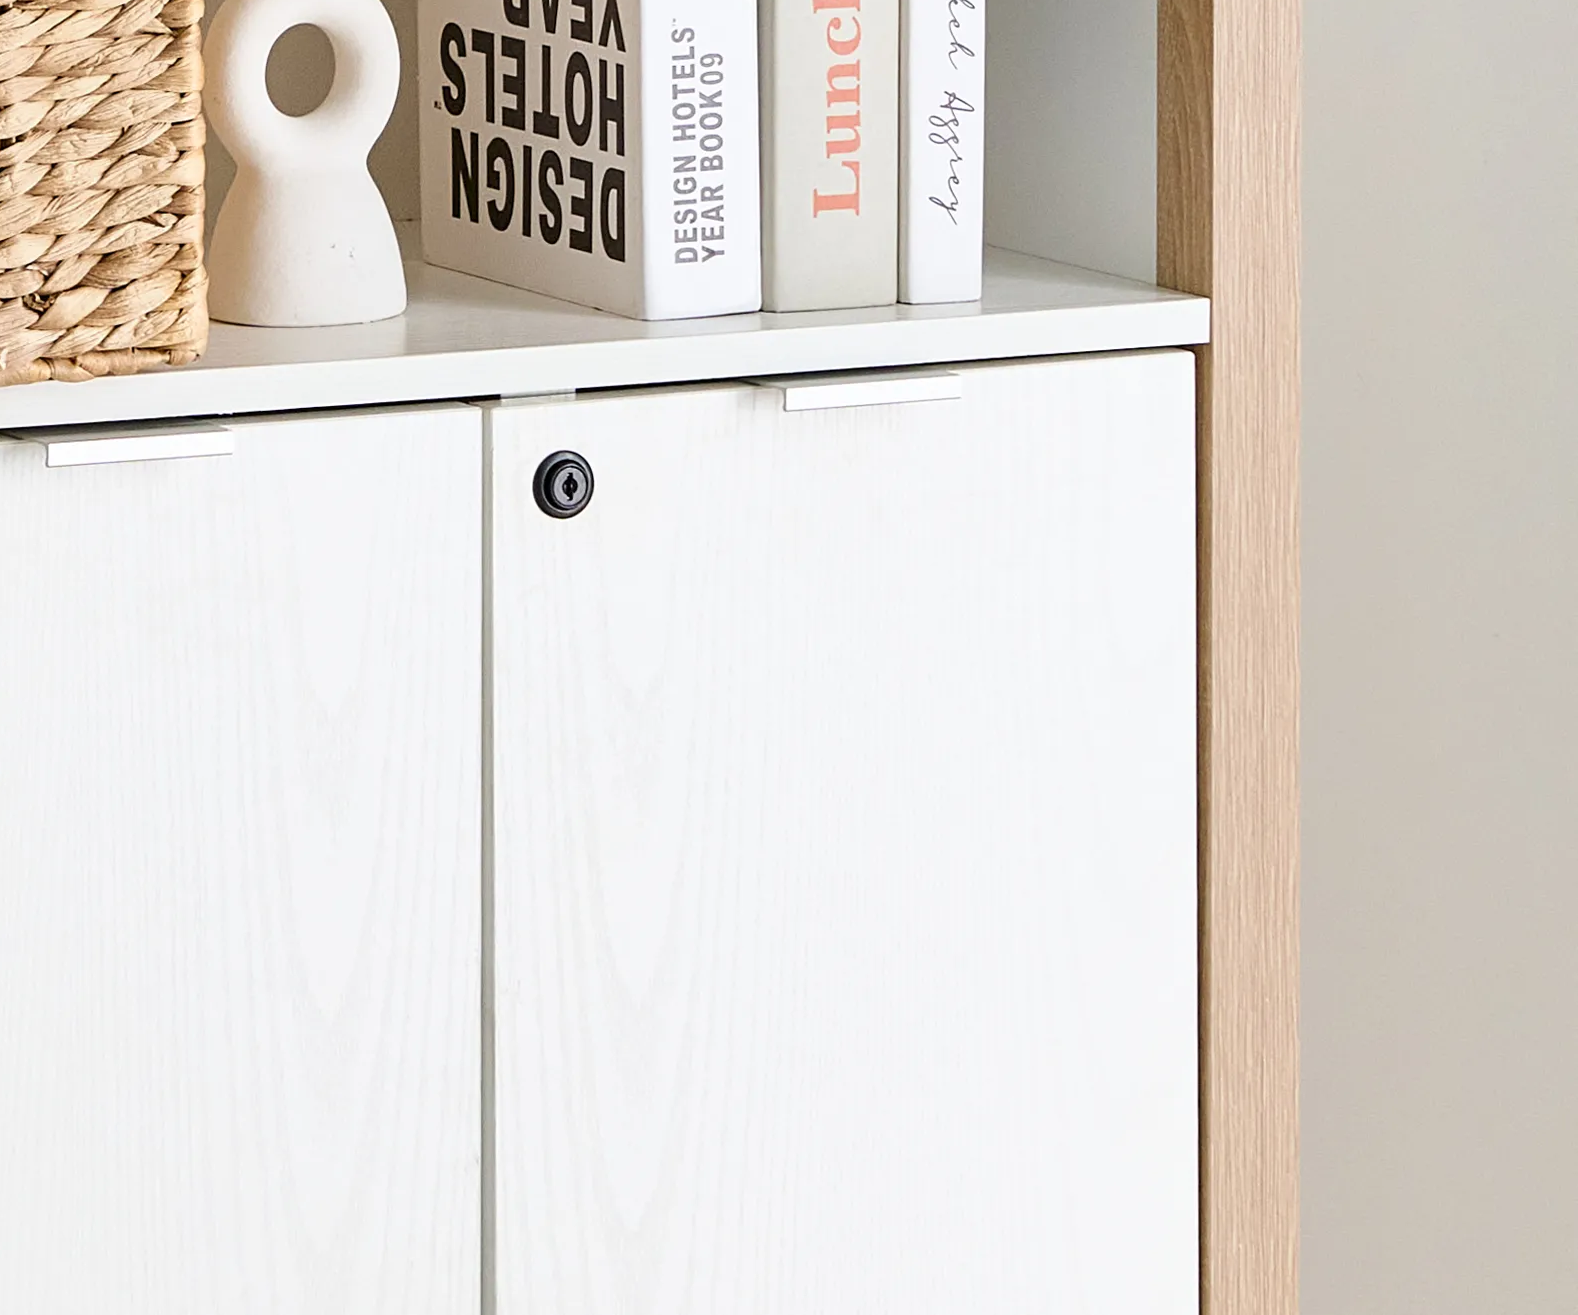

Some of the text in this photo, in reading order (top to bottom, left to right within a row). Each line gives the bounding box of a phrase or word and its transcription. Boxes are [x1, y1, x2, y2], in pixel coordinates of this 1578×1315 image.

[450, 127, 626, 263] DESIGN
[673, 155, 698, 264] DESIGN
[701, 183, 725, 263] YEAR
